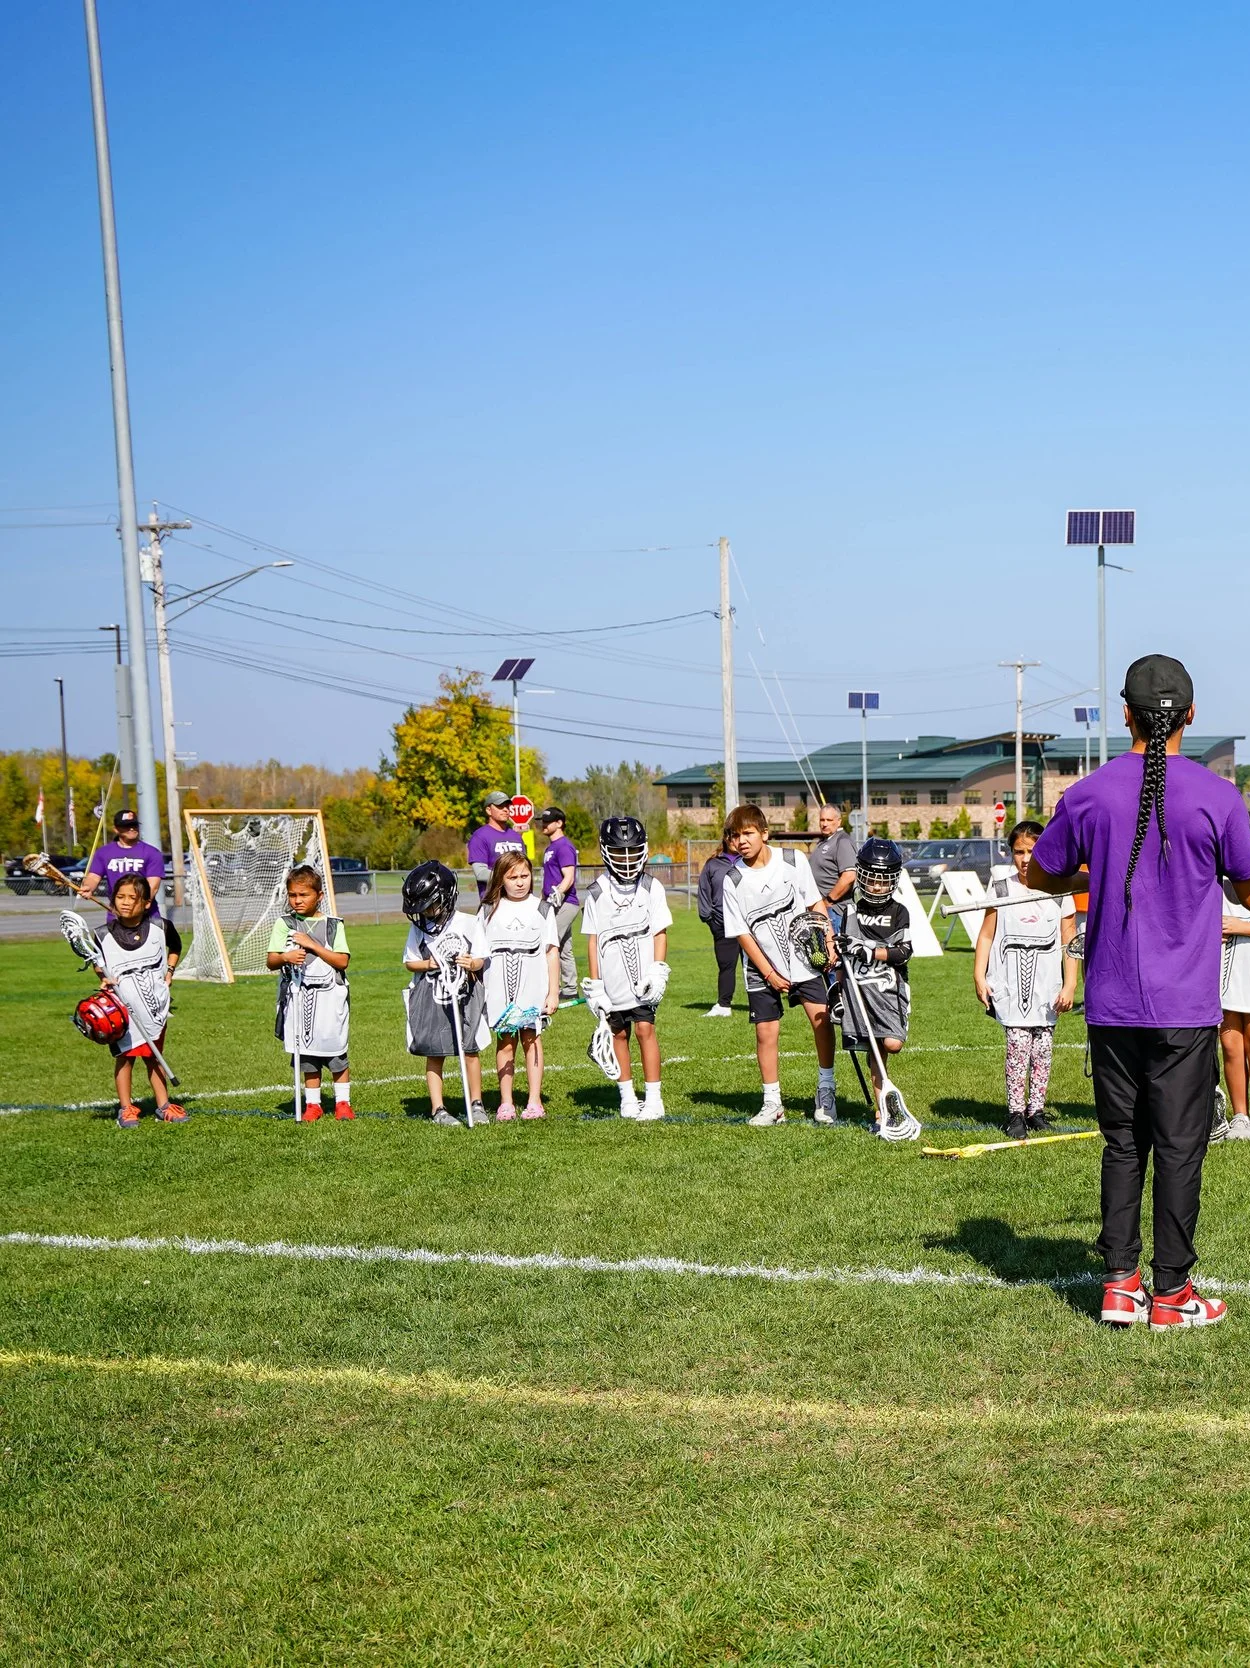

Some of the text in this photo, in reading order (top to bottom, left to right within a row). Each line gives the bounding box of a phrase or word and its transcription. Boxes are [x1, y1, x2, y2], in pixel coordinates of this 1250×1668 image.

[509, 804, 532, 816] STOP
[107, 857, 145, 873] 4TFF
[857, 913, 891, 927] NIKE
